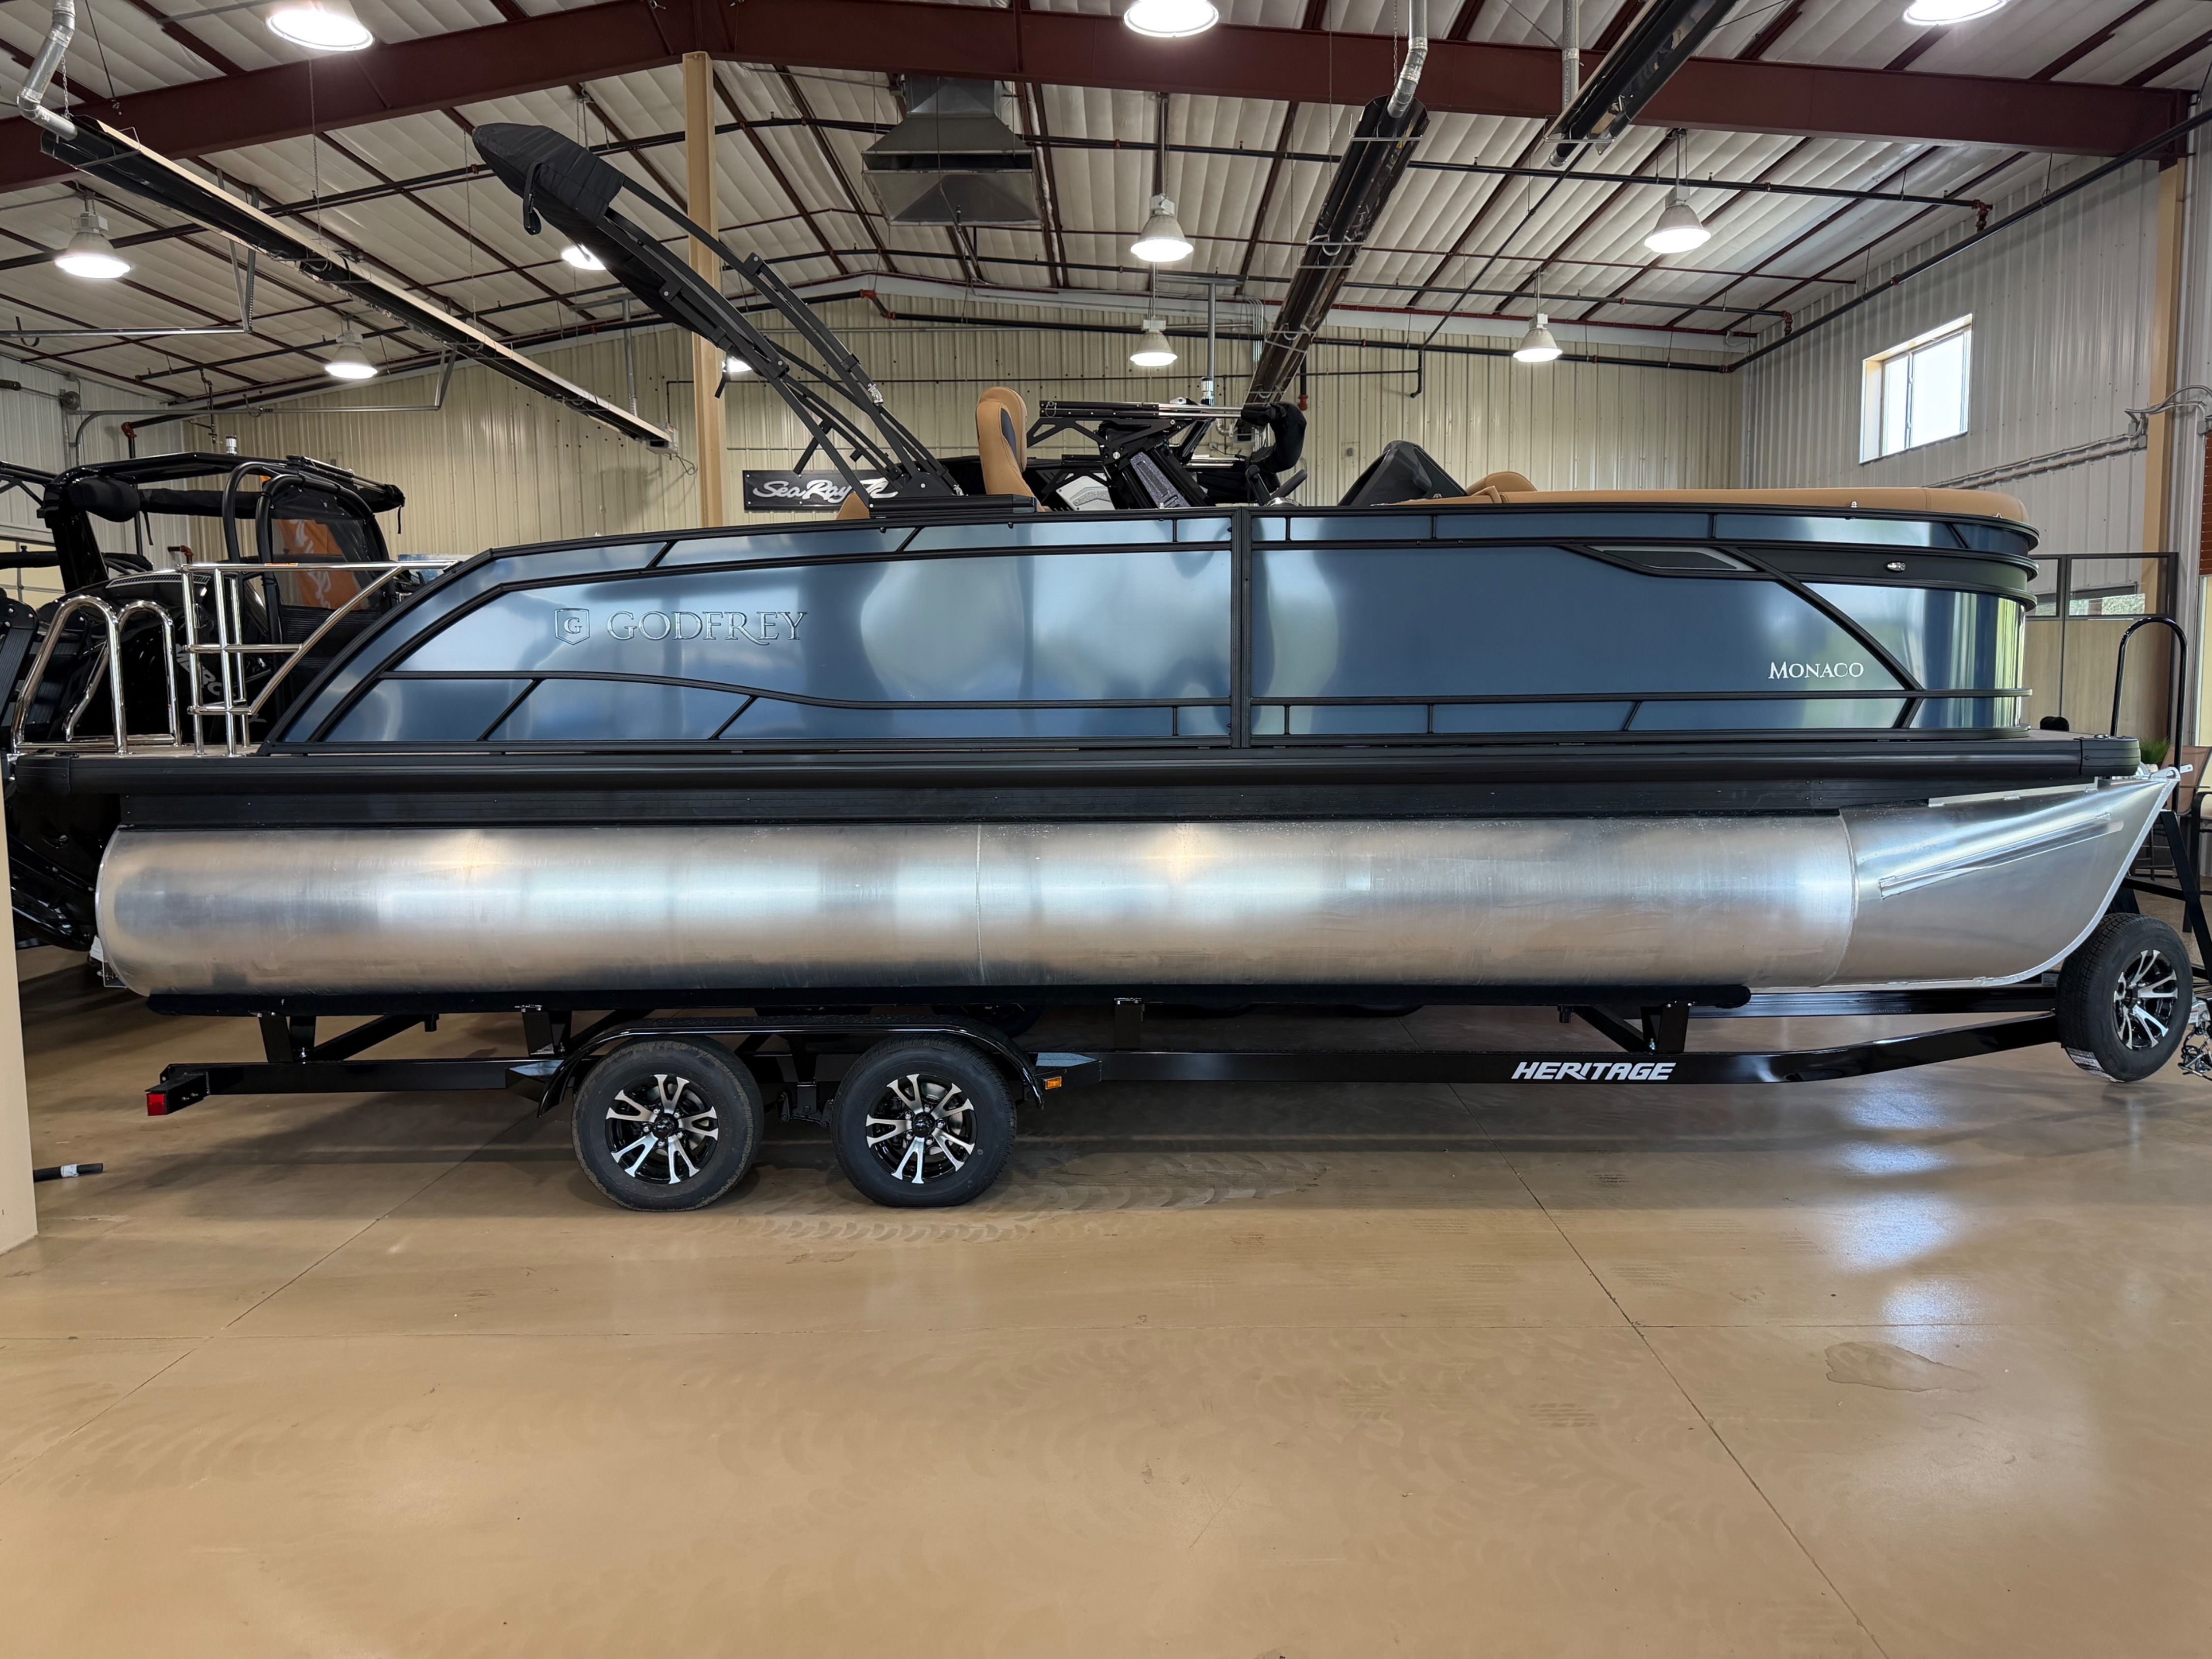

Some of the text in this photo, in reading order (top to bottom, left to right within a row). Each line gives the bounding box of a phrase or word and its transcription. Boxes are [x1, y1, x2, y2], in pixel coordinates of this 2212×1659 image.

[563, 611, 808, 645] G GODFREY
[1768, 661, 1864, 679] MONACO
[1511, 1062, 1676, 1080] HERITAGE
